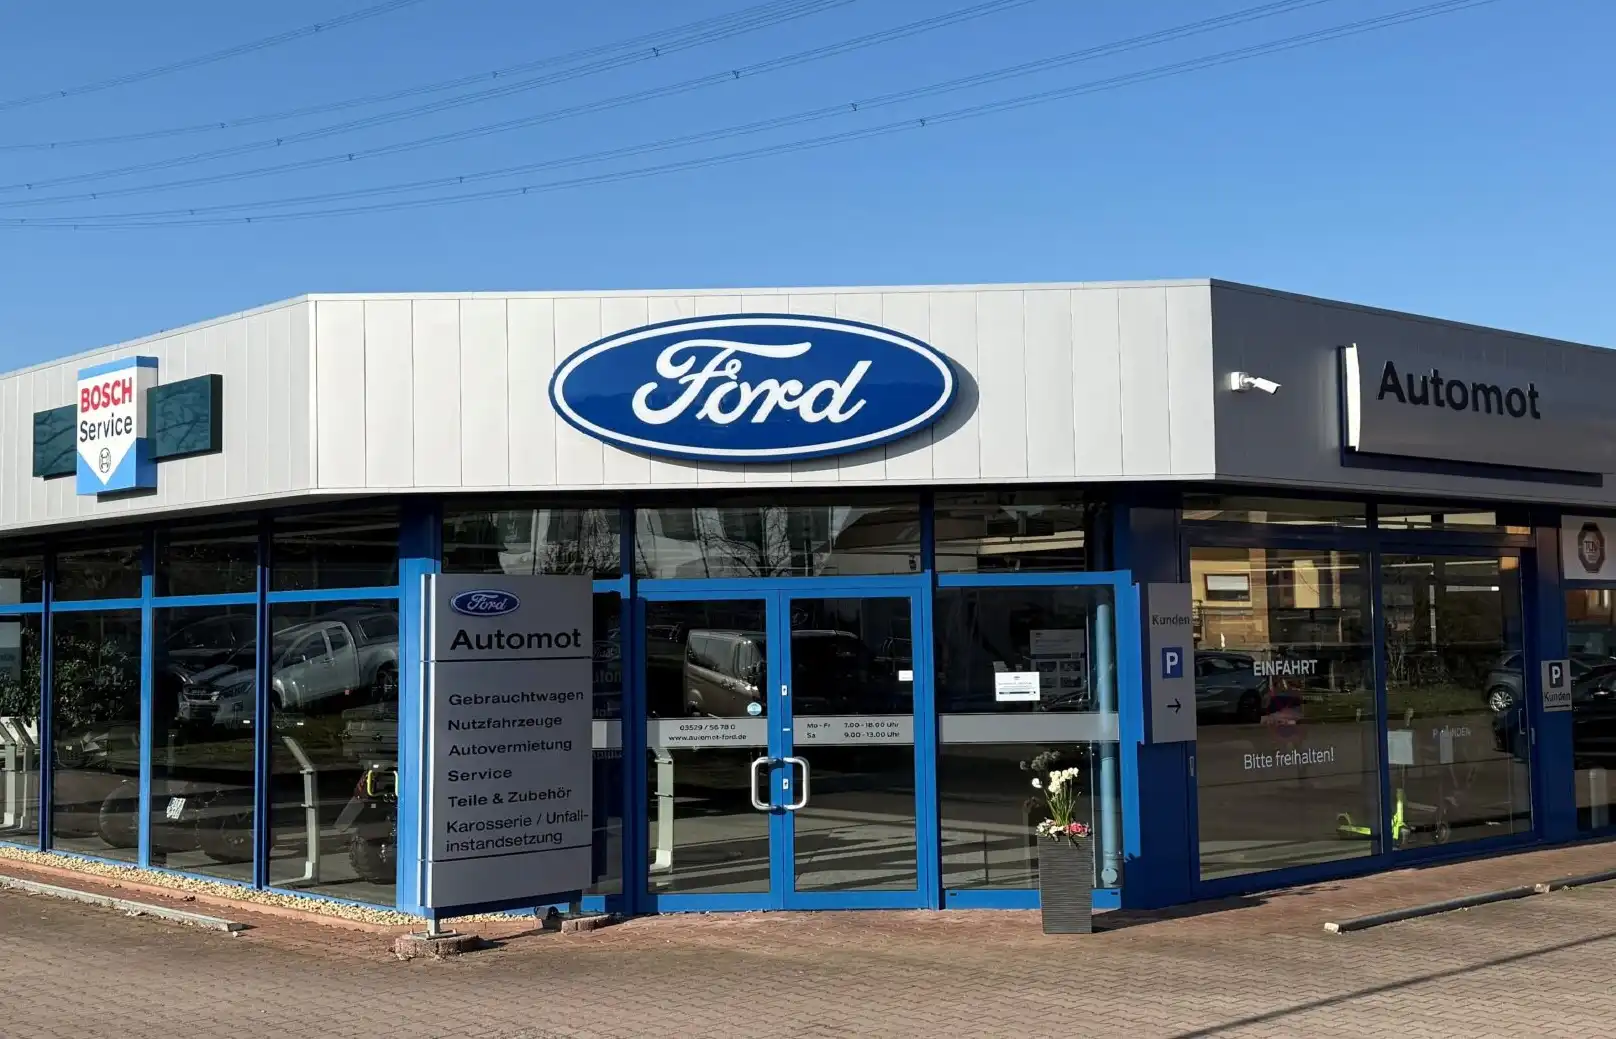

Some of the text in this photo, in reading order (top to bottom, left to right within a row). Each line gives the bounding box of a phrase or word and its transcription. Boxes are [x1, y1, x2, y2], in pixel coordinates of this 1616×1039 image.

[632, 339, 872, 425] Ford
[1376, 361, 1541, 420] Automot
[81, 377, 133, 413] BOSCH
[80, 412, 133, 442] Service
[467, 593, 508, 611] Ford
[1152, 614, 1190, 626] Kunden
[450, 628, 582, 650] Automot
[1165, 651, 1178, 674] P
[1253, 659, 1318, 677] EINFAHRT
[1552, 665, 1561, 685] P
[449, 691, 584, 706] Gebrauchtwagen
[1544, 691, 1571, 702] Kunden
[447, 716, 563, 731] Nutzfahrzeuge
[448, 740, 572, 757] Autovermietung
[1244, 747, 1334, 770] Bitte freihalten!
[448, 768, 512, 782] Service
[448, 786, 572, 808] Teile & Zubehör
[446, 809, 589, 833] Karosserie / Unfall-
[446, 832, 563, 852] instandsetzung
